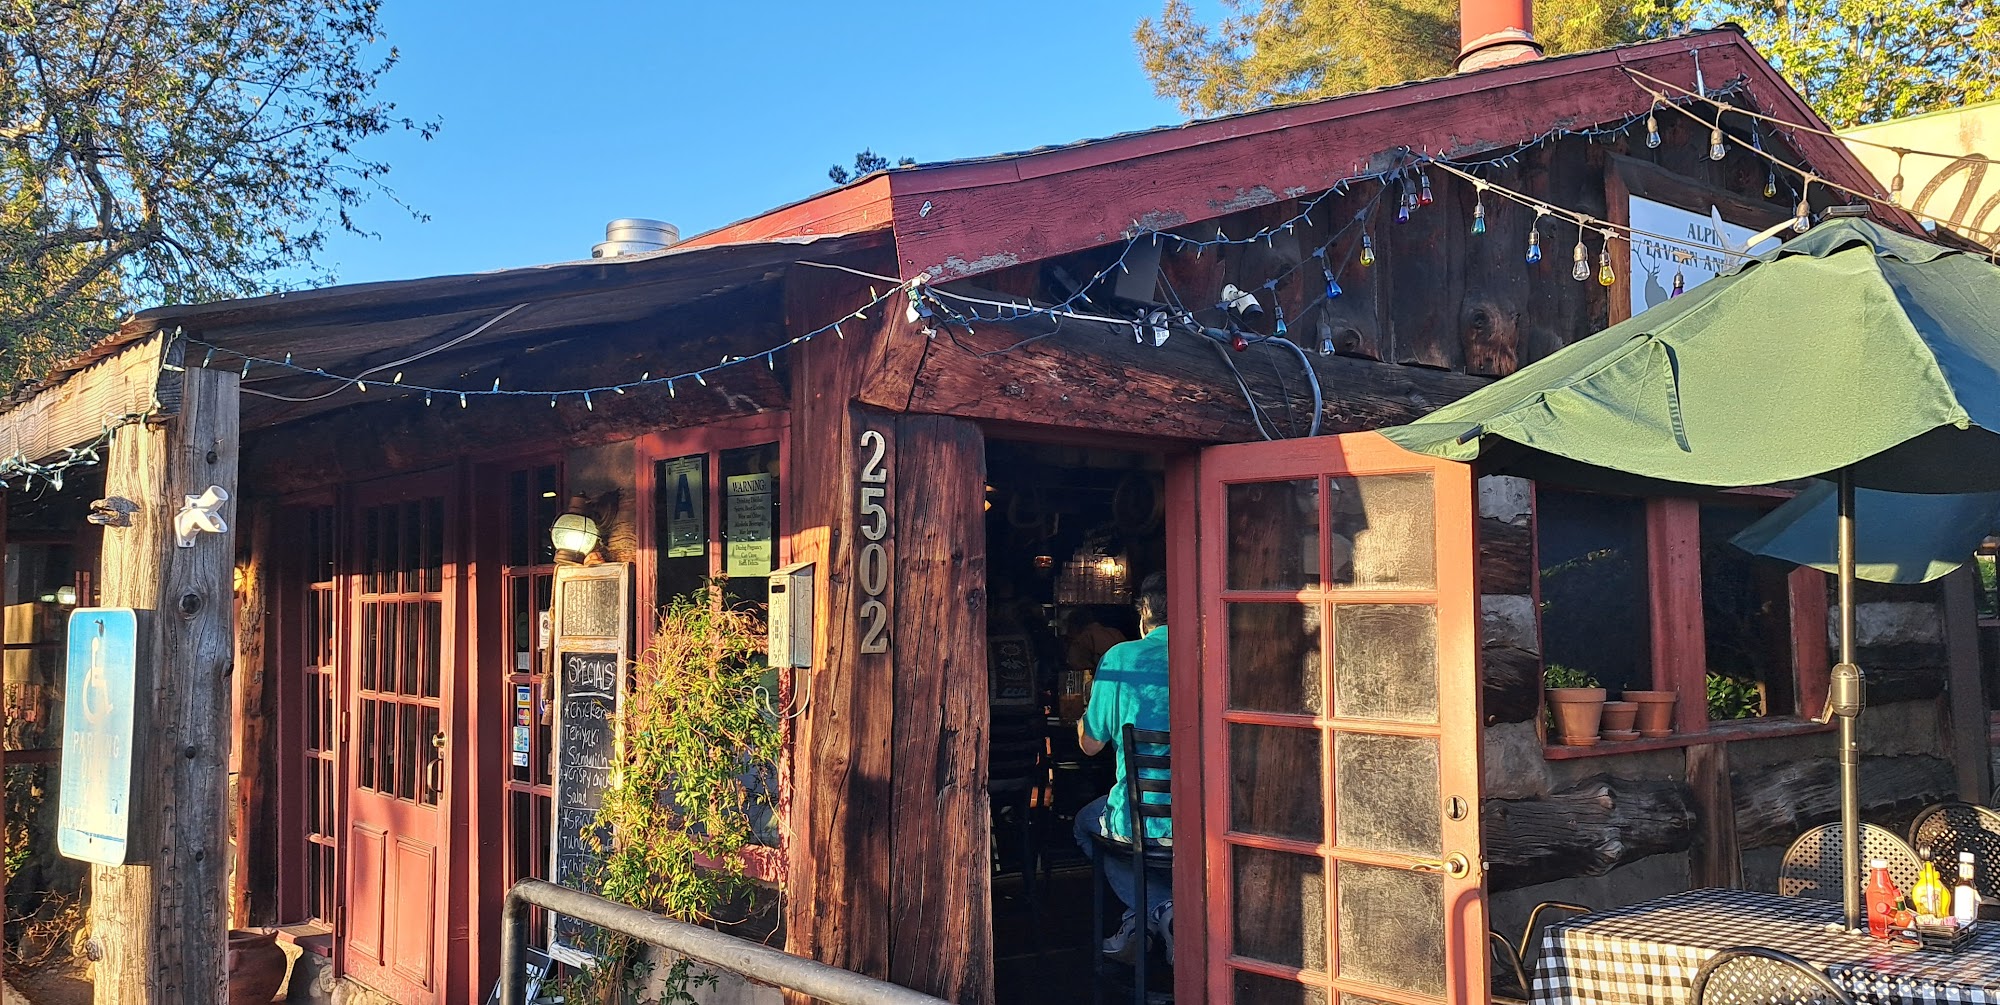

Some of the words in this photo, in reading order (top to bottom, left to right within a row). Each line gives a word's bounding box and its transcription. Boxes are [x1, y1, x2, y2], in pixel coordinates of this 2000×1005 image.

[1687, 222, 1731, 247] ALPI
[1703, 254, 1726, 274] AN
[674, 473, 696, 520] A
[859, 430, 888, 654] 2502
[568, 656, 616, 691] SPECIALS
